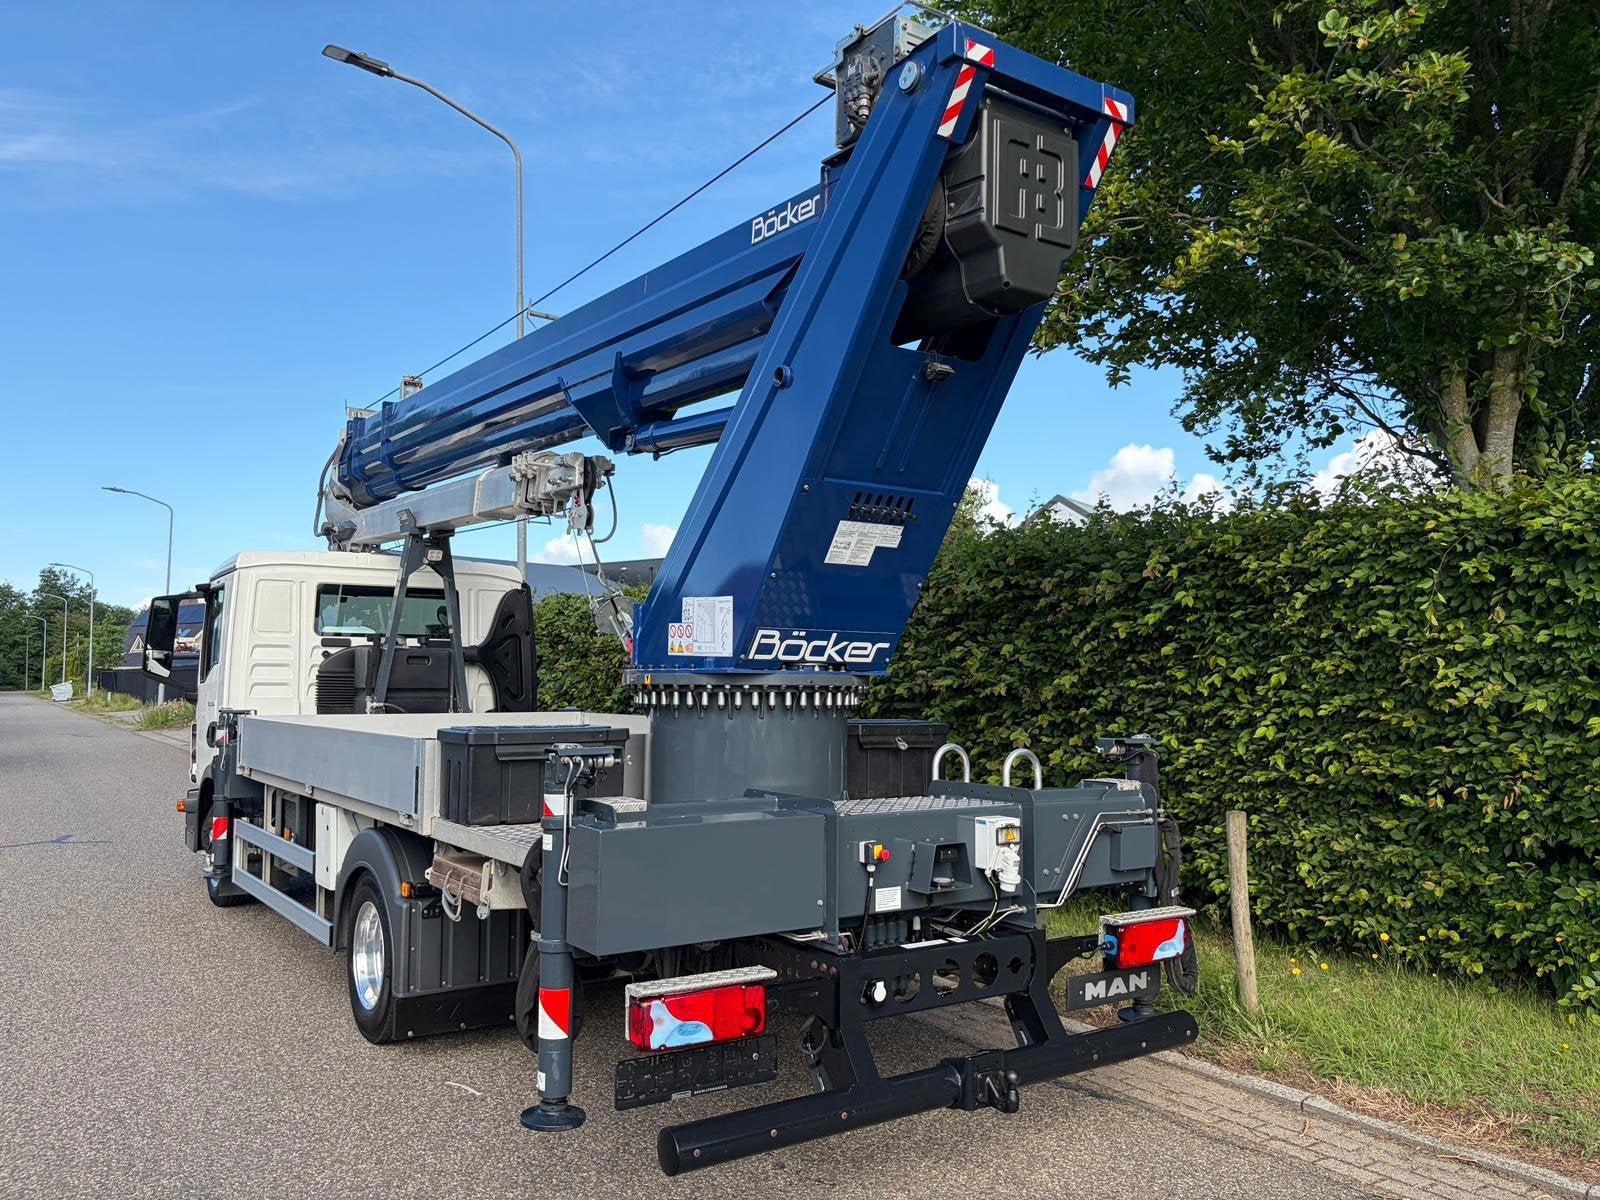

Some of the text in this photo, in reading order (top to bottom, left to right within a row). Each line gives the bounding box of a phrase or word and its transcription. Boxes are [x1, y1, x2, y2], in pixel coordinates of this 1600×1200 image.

[751, 194, 821, 245] Böcker
[748, 629, 890, 663] Böcker
[1085, 971, 1148, 1001] MAN
